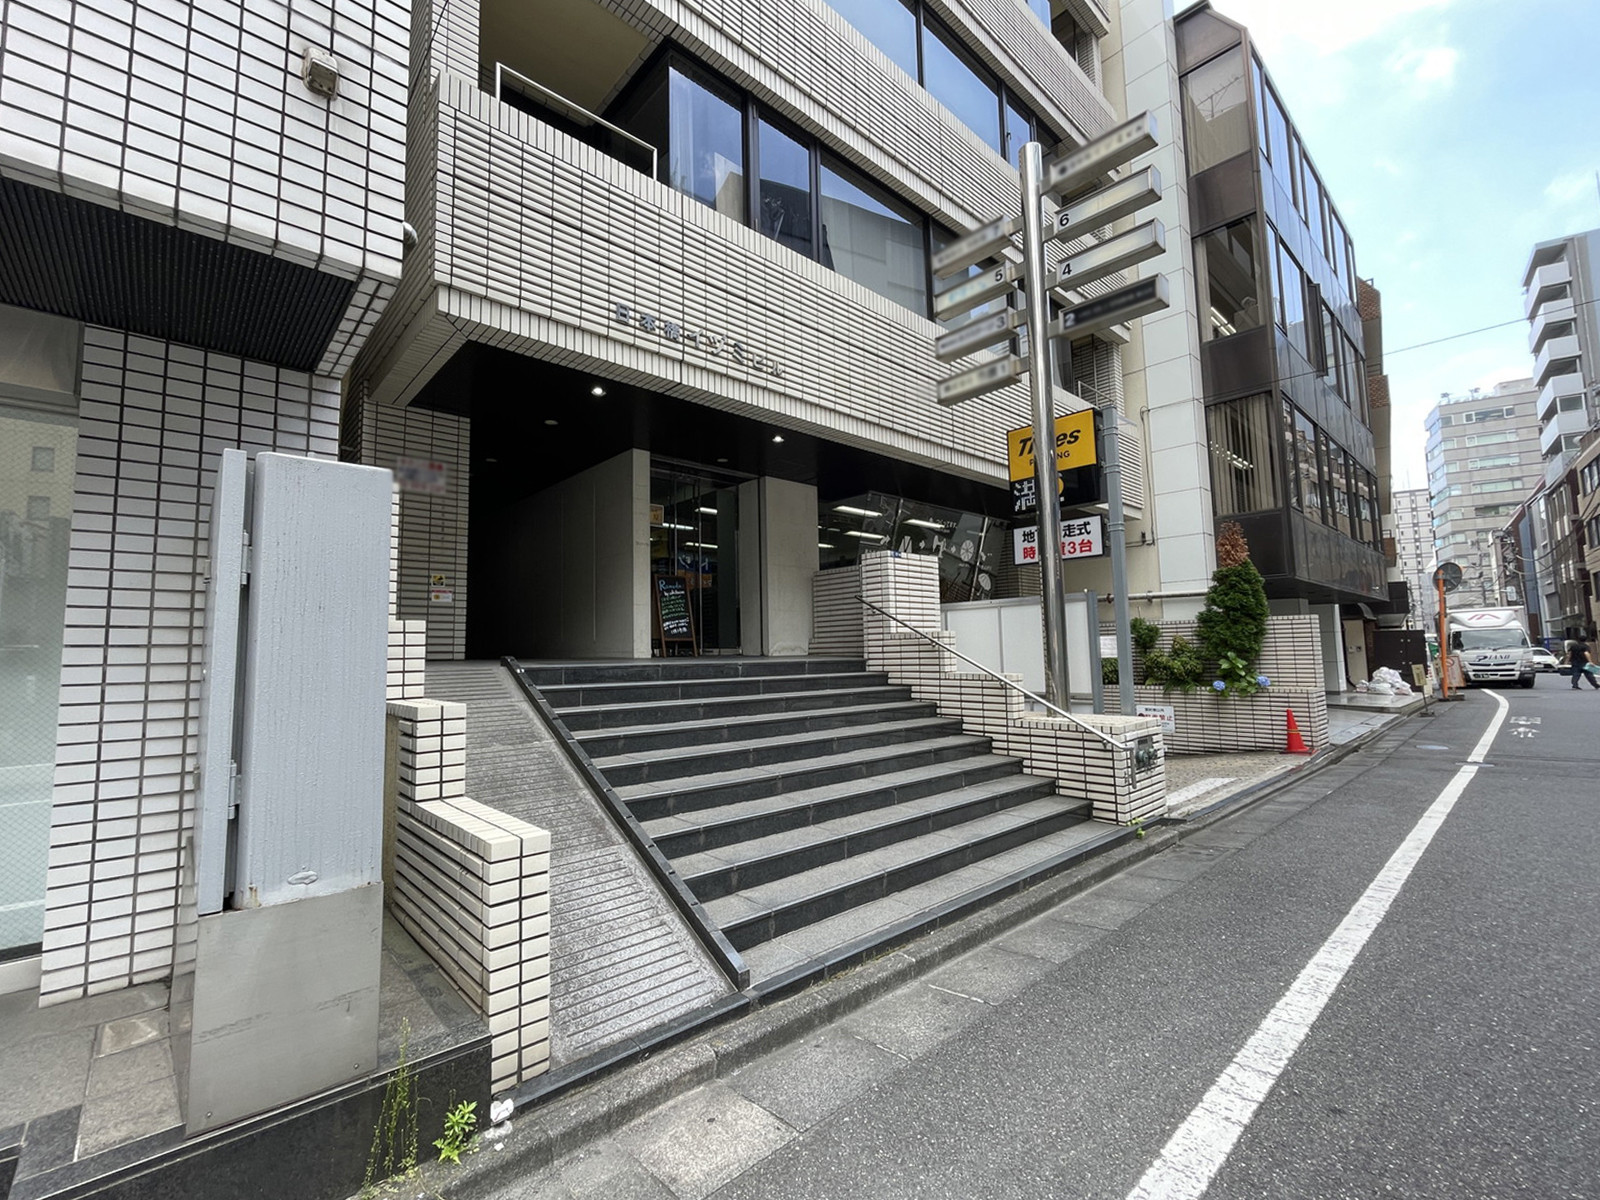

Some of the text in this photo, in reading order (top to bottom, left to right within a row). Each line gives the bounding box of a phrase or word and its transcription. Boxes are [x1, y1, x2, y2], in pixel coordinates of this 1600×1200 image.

[1059, 213, 1070, 226] 6
[994, 269, 1004, 282] 5
[1061, 263, 1072, 276] 4
[1018, 429, 1081, 456] Ties
[1022, 521, 1091, 543] 地走式
[1023, 538, 1093, 560] 時3台
